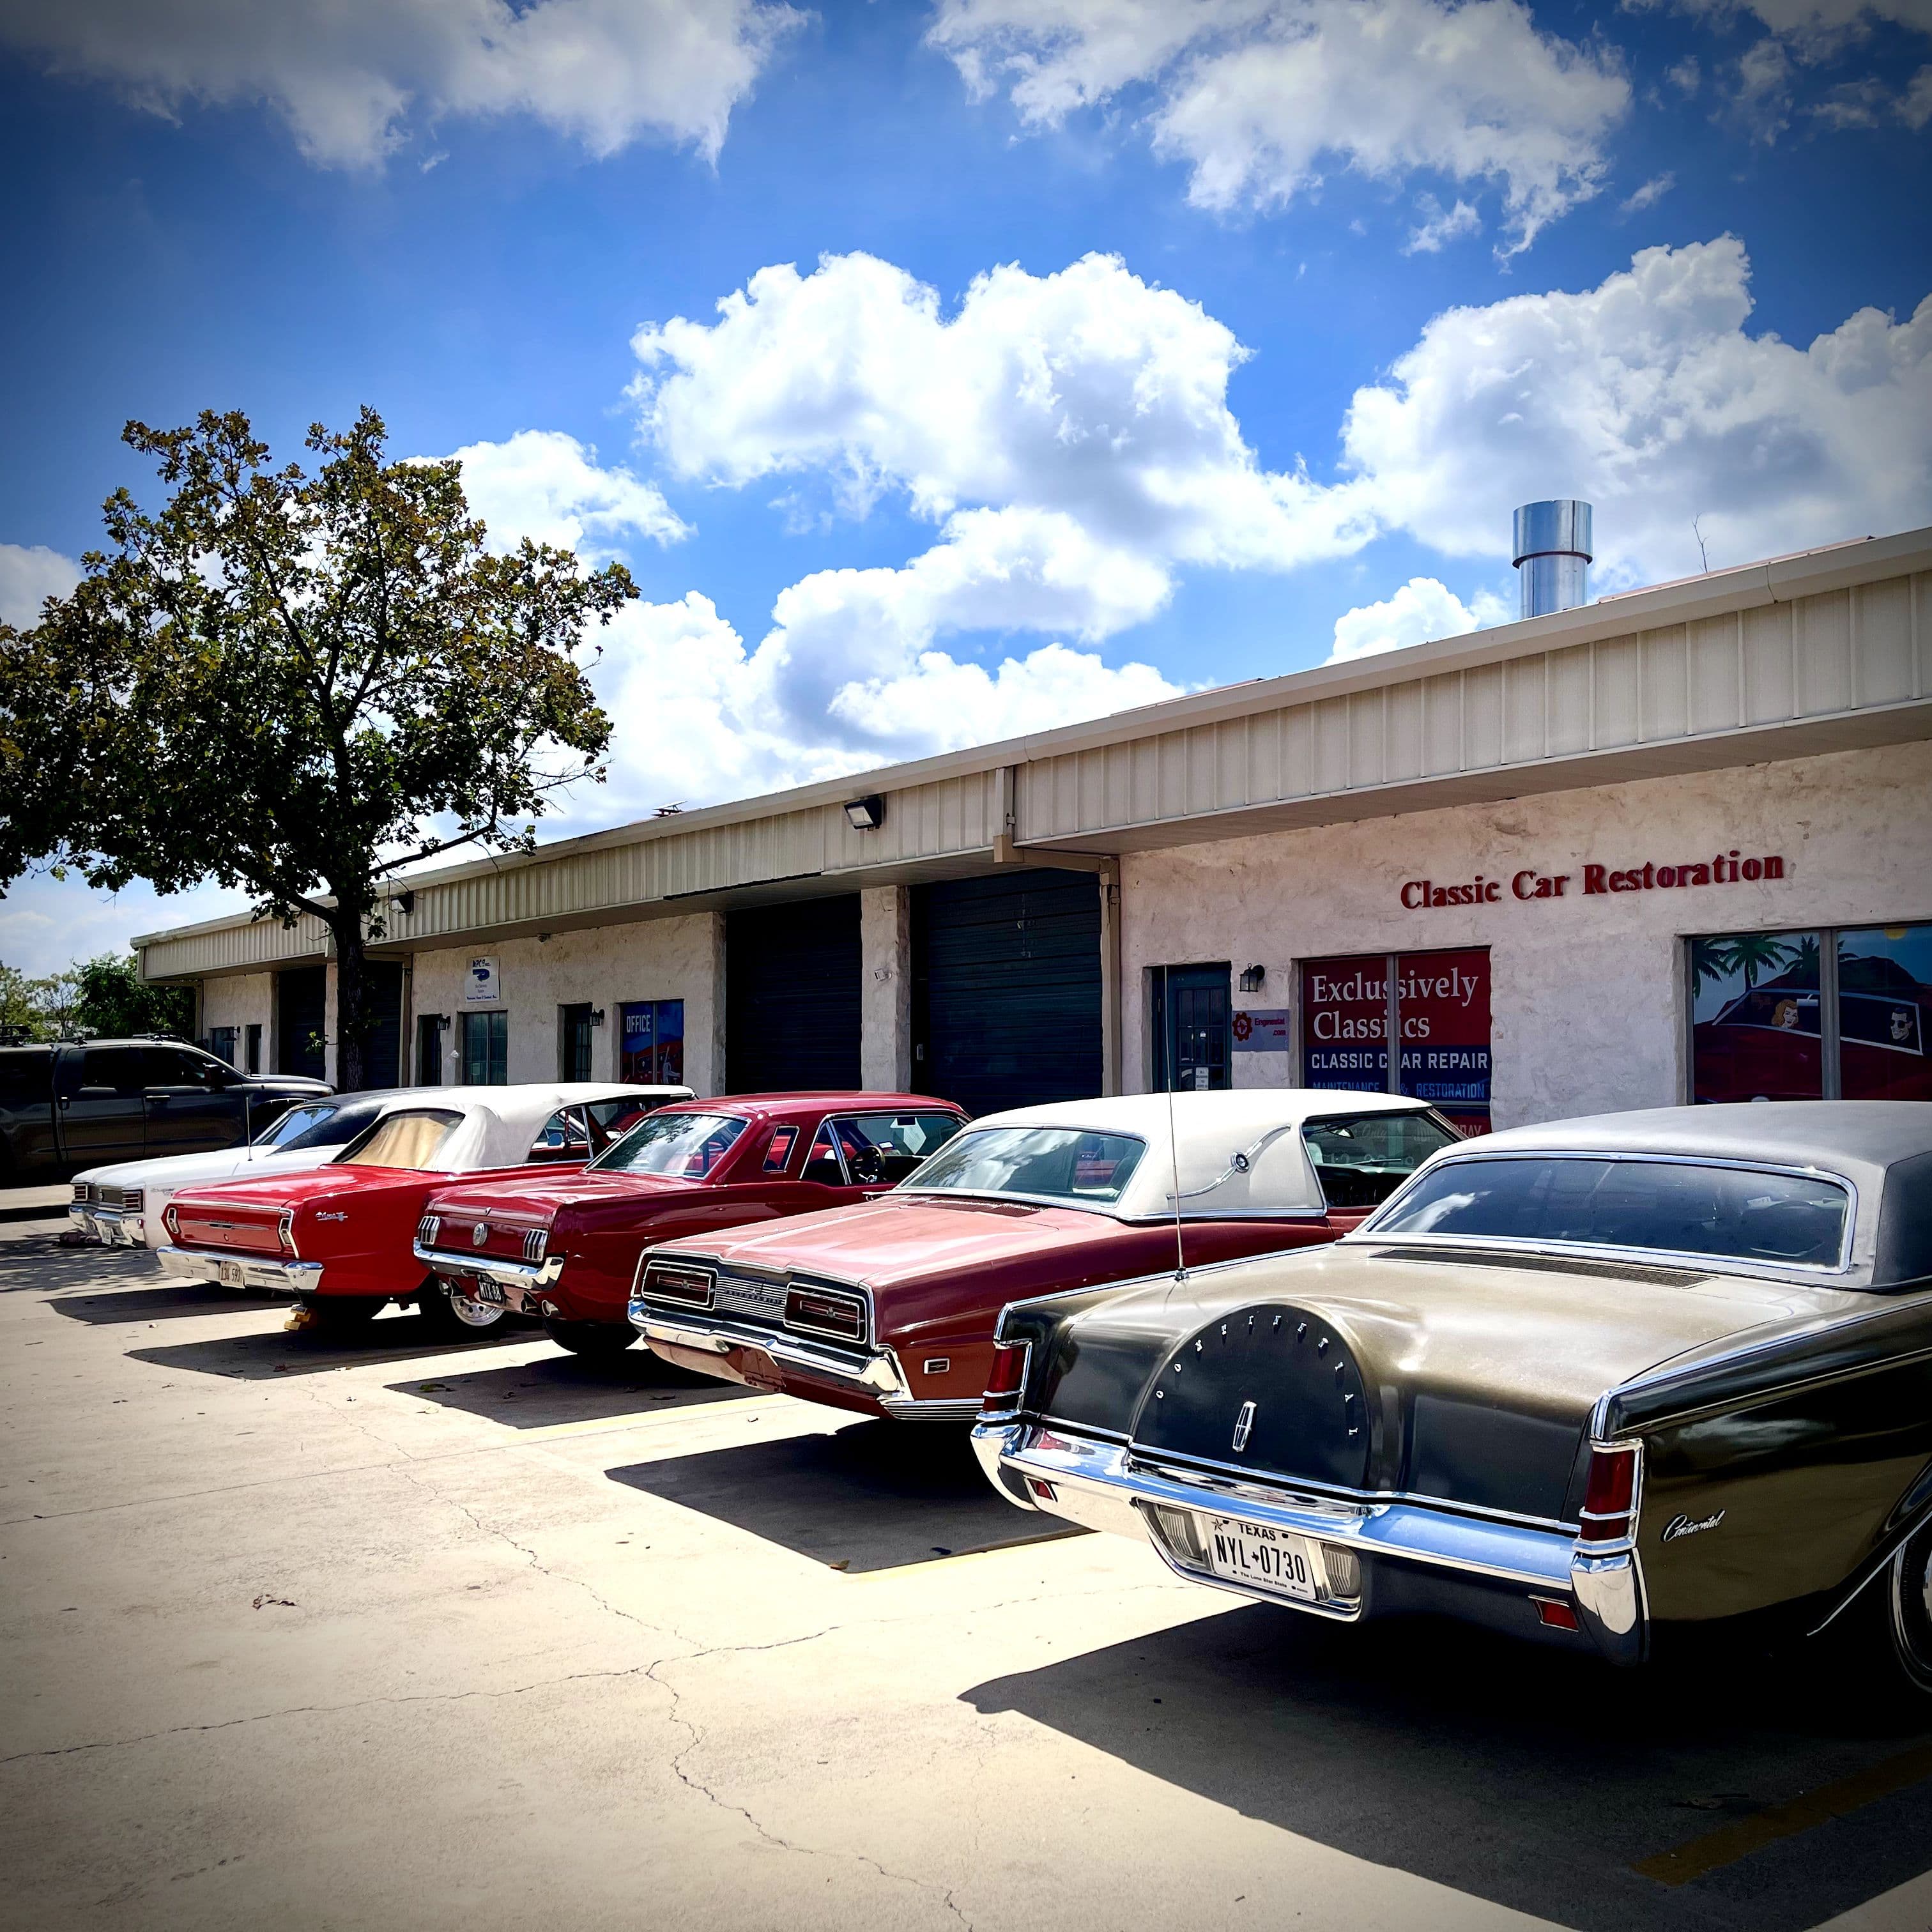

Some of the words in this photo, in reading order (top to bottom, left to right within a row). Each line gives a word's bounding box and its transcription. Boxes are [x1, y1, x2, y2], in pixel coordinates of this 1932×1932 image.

[1400, 875, 1502, 909] Classic
[1512, 870, 1570, 900] Car
[1581, 850, 1784, 894] Restoration
[1312, 966, 1478, 1007] Exclusively
[626, 1015, 650, 1032] OFFICE
[1314, 1009, 1430, 1039] Classics
[1312, 1053, 1373, 1069] CLASSIC
[1379, 1053, 1422, 1069] CAR
[1428, 1052, 1487, 1069] REPAIR
[1416, 1083, 1485, 1098] RESTORATION
[1238, 1522, 1276, 1541] TEXAS
[1664, 1510, 1726, 1542] Continental
